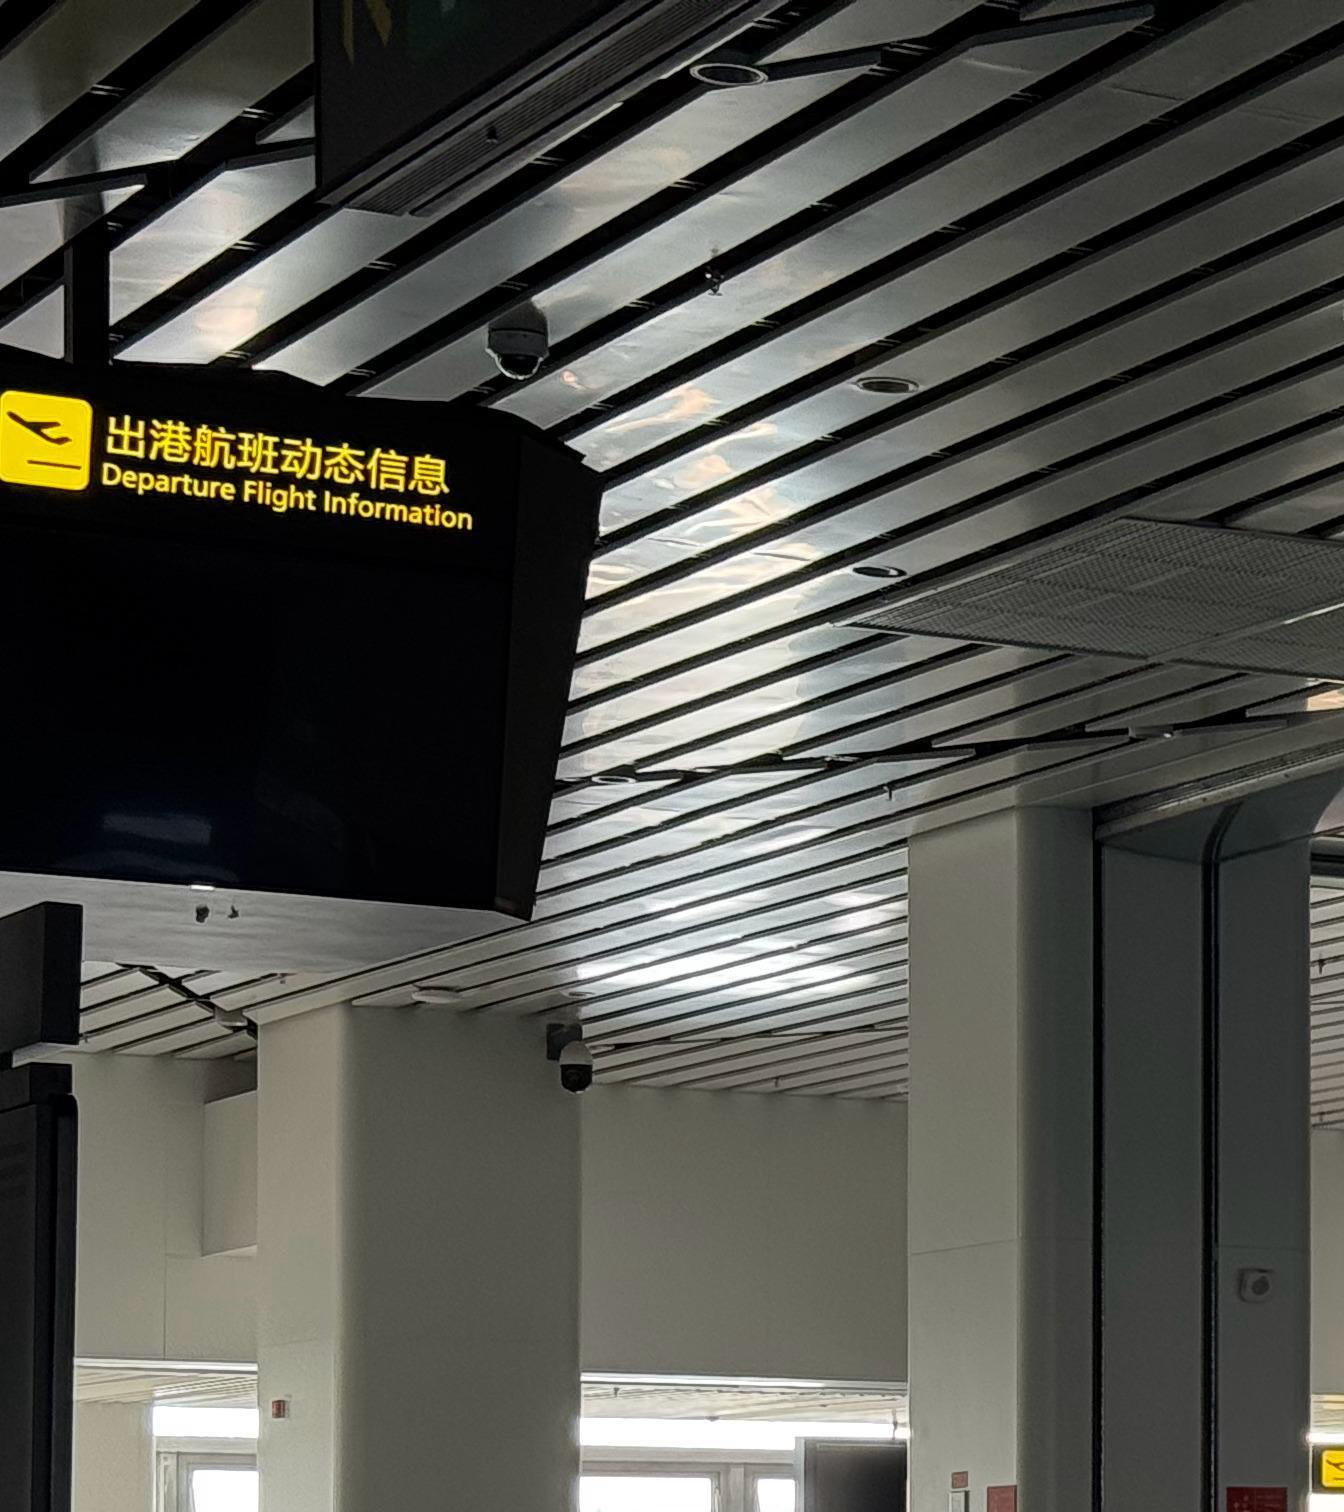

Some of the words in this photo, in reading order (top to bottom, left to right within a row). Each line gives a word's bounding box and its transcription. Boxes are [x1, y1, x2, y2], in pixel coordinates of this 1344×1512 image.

[106, 415, 450, 496] 出港航班动态信息
[102, 462, 236, 501] Departure
[243, 481, 319, 513] Flight
[324, 491, 473, 530] Information
